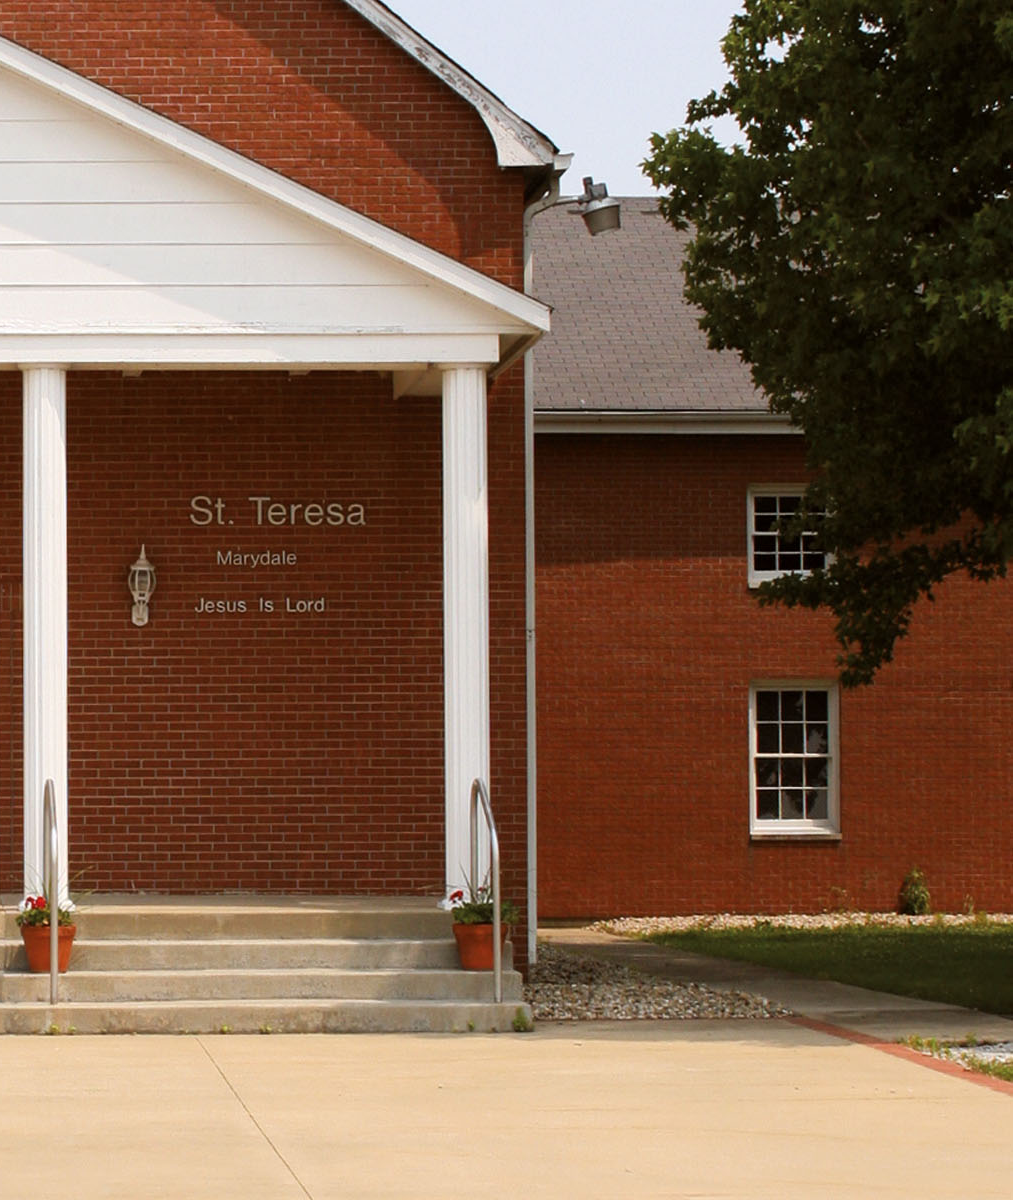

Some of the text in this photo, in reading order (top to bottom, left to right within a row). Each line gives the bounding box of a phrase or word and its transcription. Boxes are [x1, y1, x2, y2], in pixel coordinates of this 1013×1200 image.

[189, 496, 366, 525] St. Teresa
[217, 550, 297, 568] Marydale
[194, 597, 324, 613] Jesus Is Lord
